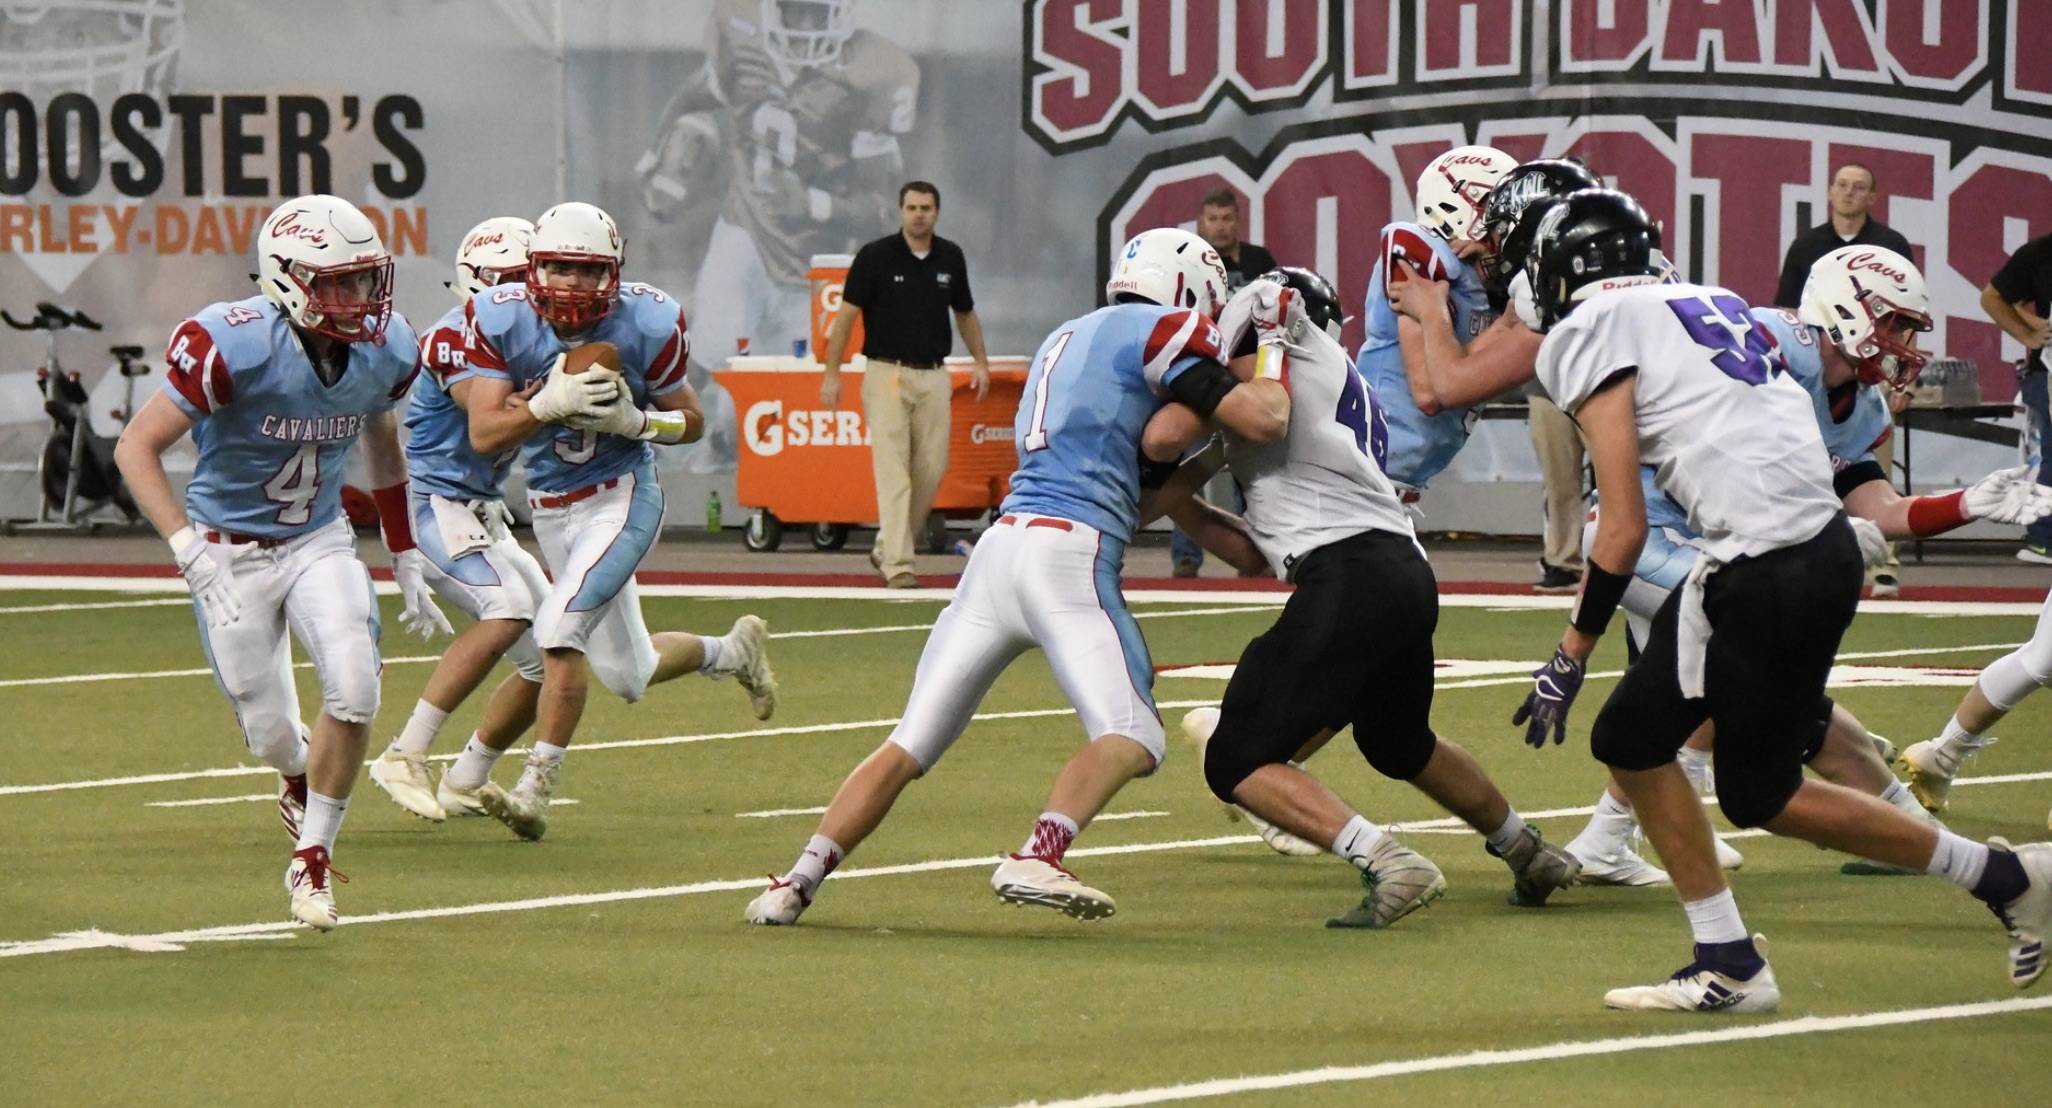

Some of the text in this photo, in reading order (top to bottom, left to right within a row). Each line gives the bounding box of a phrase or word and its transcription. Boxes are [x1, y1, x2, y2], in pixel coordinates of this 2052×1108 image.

[0, 92, 426, 199] OOSTER'S
[0, 203, 429, 257] RLEY-DAVON
[1846, 252, 1907, 285] Cavs
[224, 306, 264, 327] 4
[1024, 330, 1074, 453] 1
[260, 413, 368, 442] CAVALIERS
[743, 399, 784, 457] G
[265, 444, 324, 527] 4
